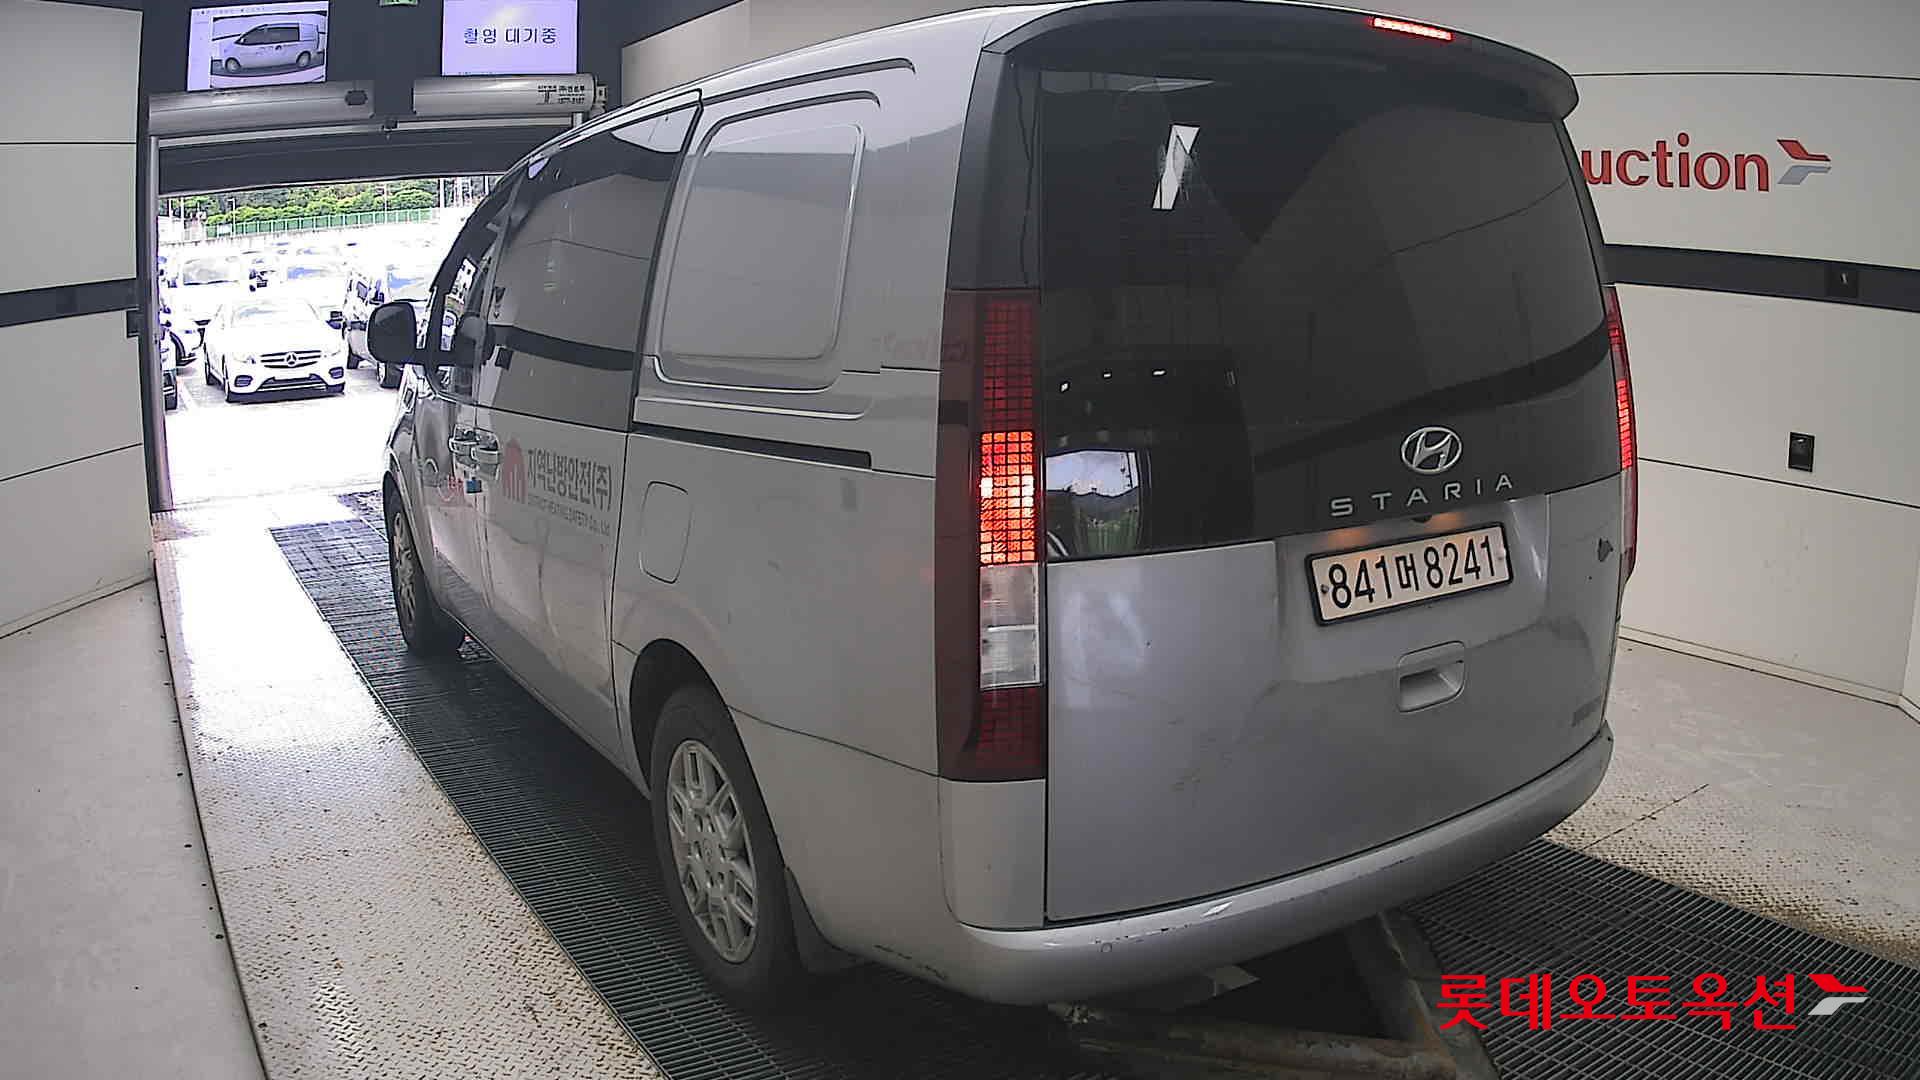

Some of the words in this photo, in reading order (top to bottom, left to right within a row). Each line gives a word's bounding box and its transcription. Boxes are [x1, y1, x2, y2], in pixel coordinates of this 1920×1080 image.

[463, 28, 497, 44] 촬영
[505, 28, 557, 44] 대기중
[1581, 132, 1770, 193] uction
[1330, 474, 1513, 517] STARIA
